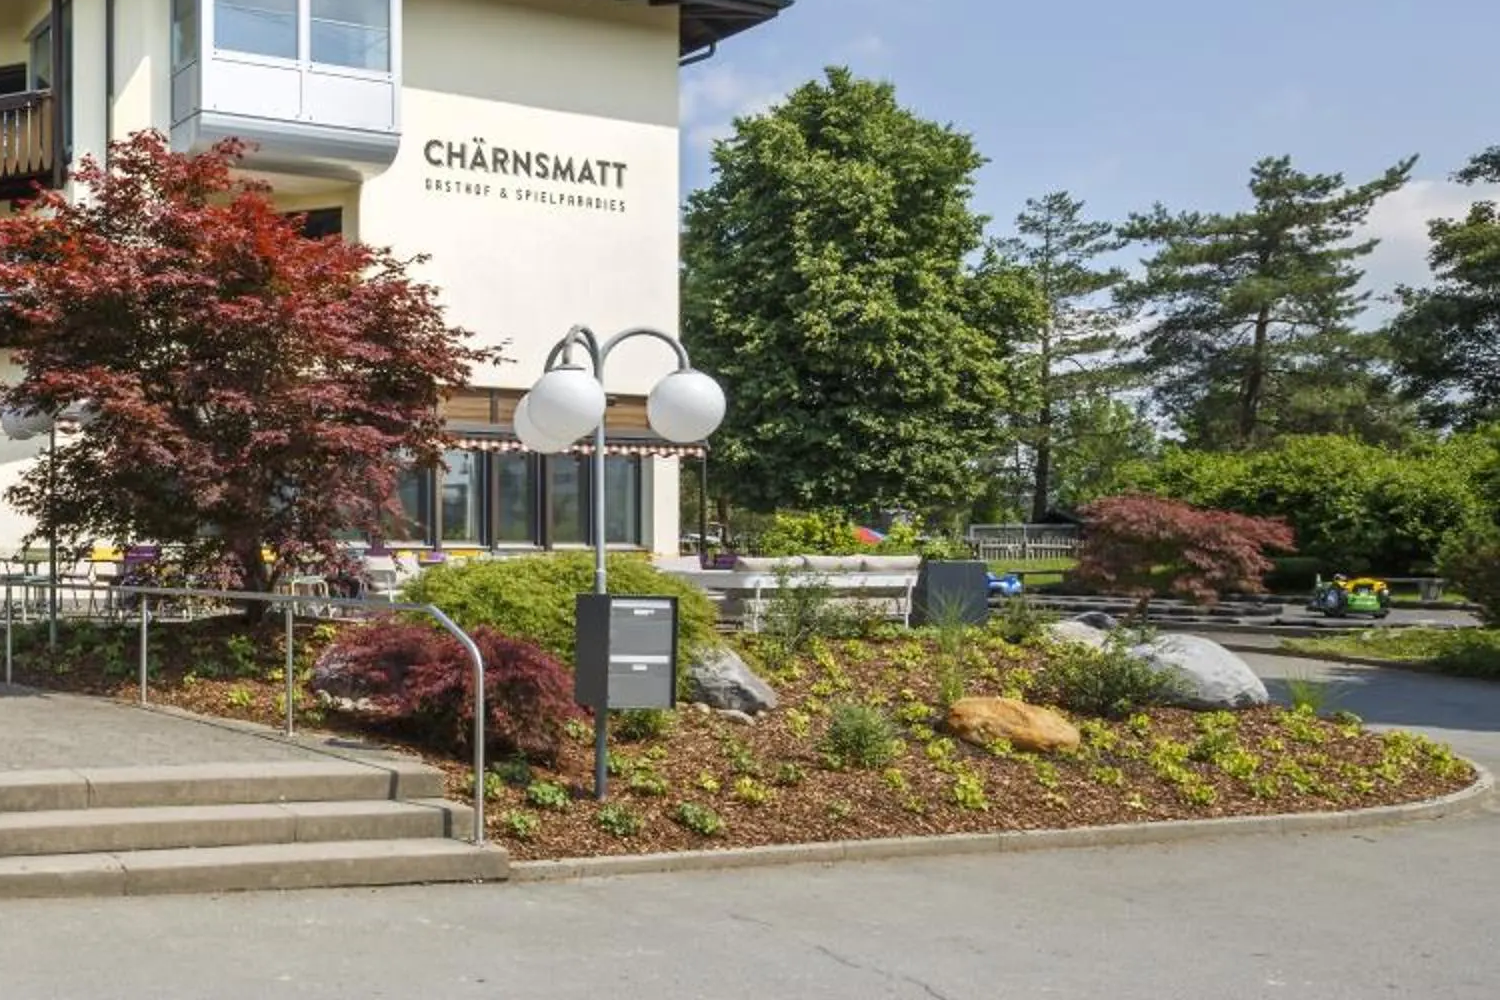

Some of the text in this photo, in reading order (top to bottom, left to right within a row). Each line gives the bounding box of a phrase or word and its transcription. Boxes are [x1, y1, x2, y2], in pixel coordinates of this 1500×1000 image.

[423, 136, 628, 189] CHÄRNSMATT
[424, 177, 491, 197] GASTHOF
[499, 187, 508, 199] &
